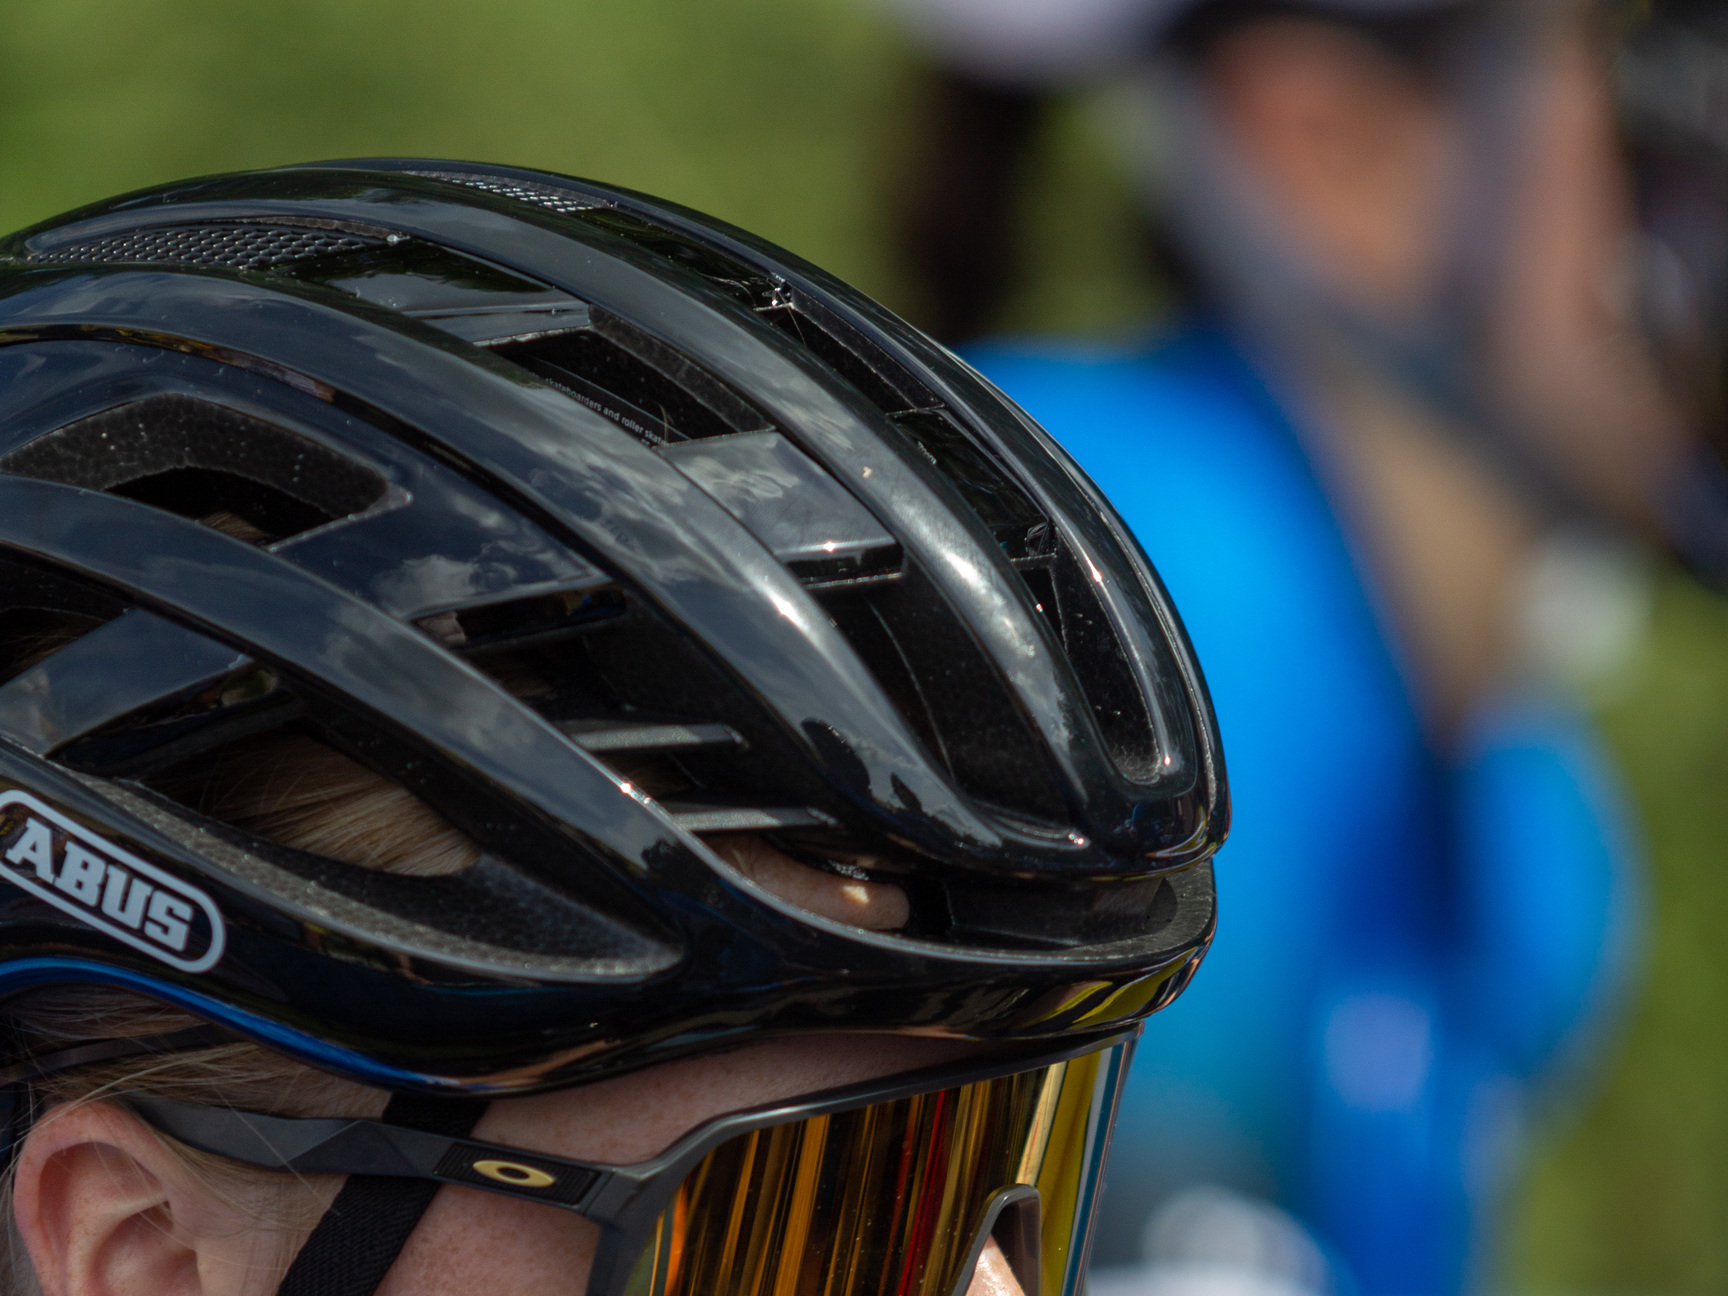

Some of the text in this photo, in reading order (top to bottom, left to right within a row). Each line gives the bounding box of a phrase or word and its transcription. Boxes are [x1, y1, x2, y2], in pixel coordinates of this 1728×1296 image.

[545, 378, 602, 411] skateboarders
[603, 406, 620, 420] and
[621, 416, 643, 433] roller
[5, 817, 193, 951] ABUS
